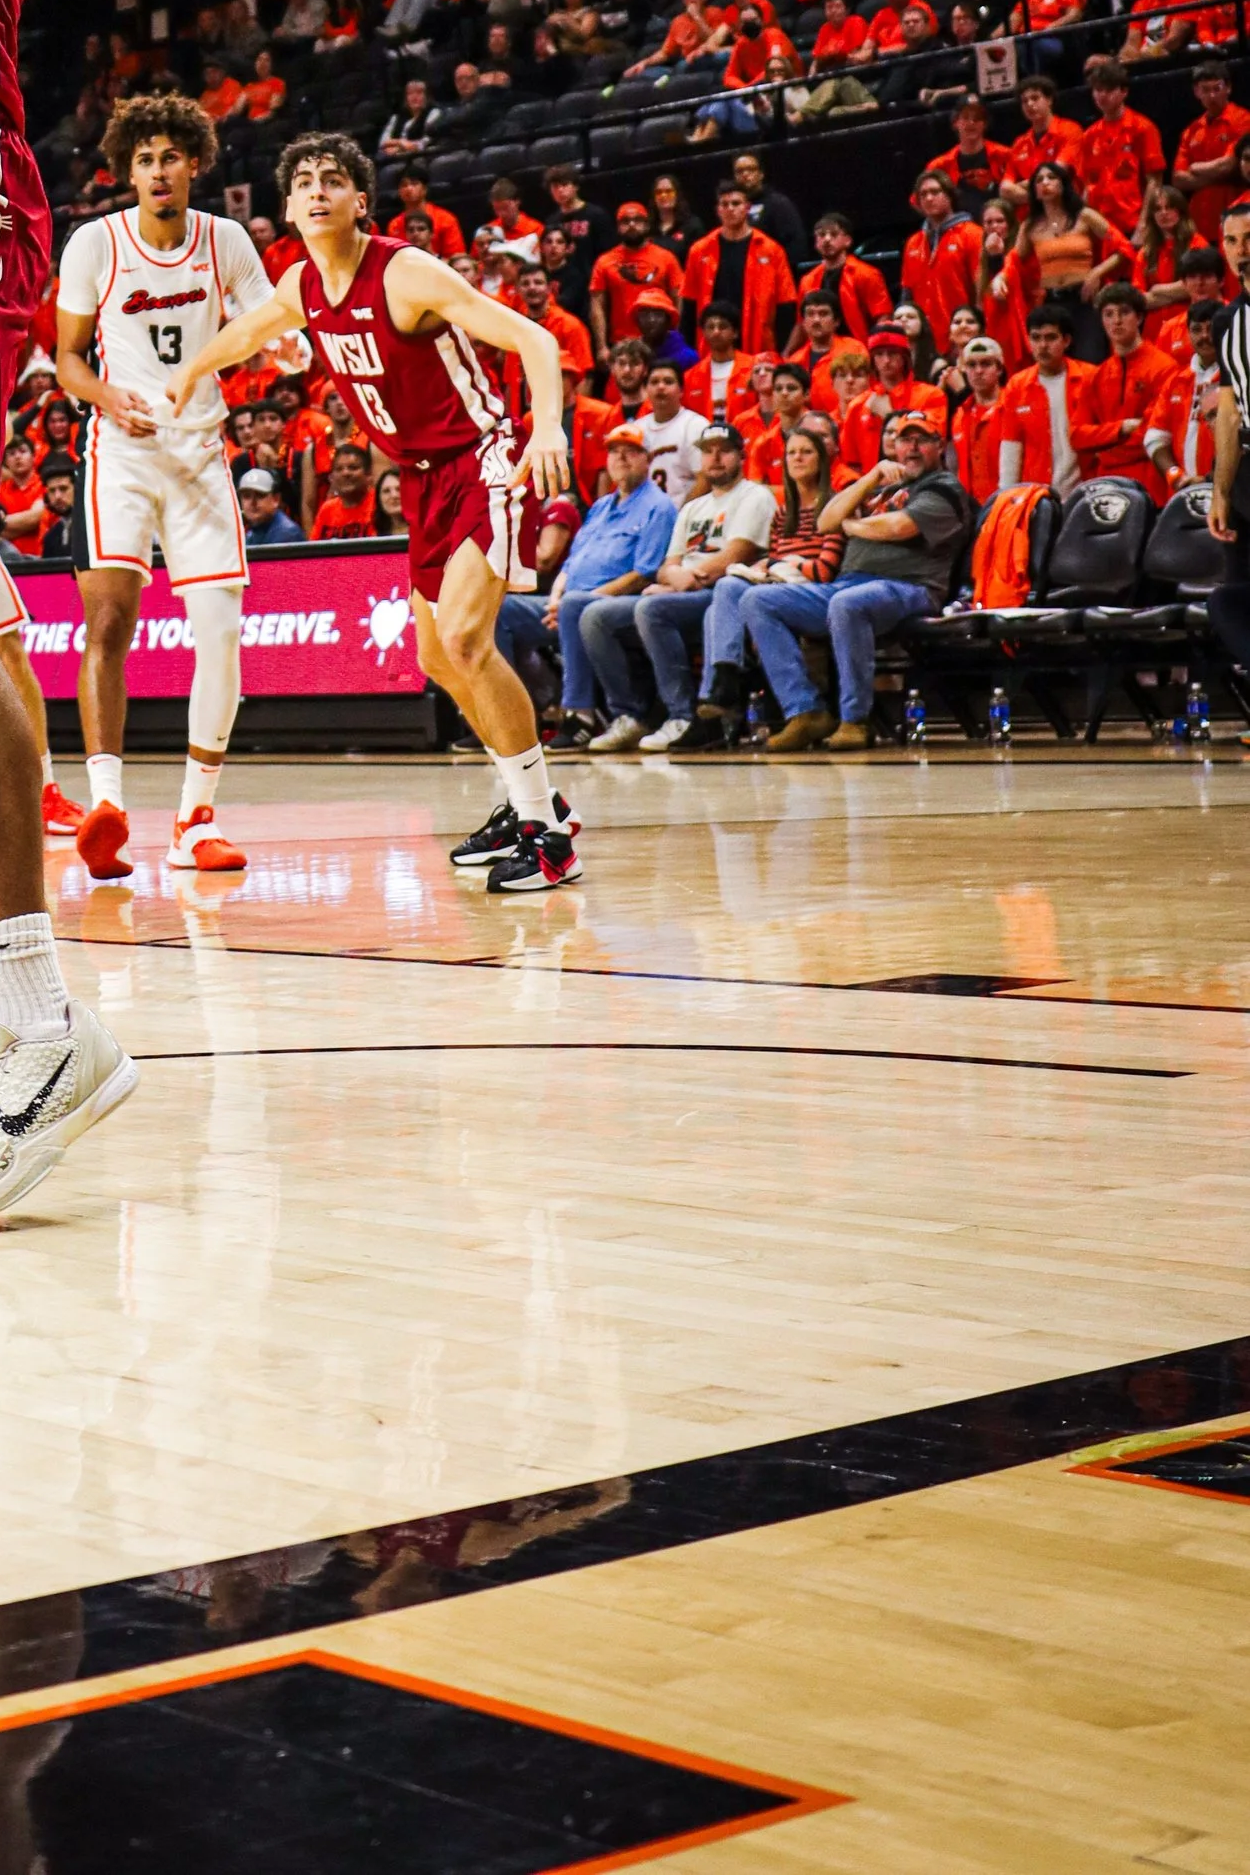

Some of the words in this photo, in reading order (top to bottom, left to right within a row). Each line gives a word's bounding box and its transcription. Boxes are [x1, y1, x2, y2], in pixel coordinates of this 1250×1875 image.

[148, 324, 182, 364] 13
[317, 331, 385, 377] WSU
[351, 382, 397, 435] 13
[23, 621, 74, 653] THE
